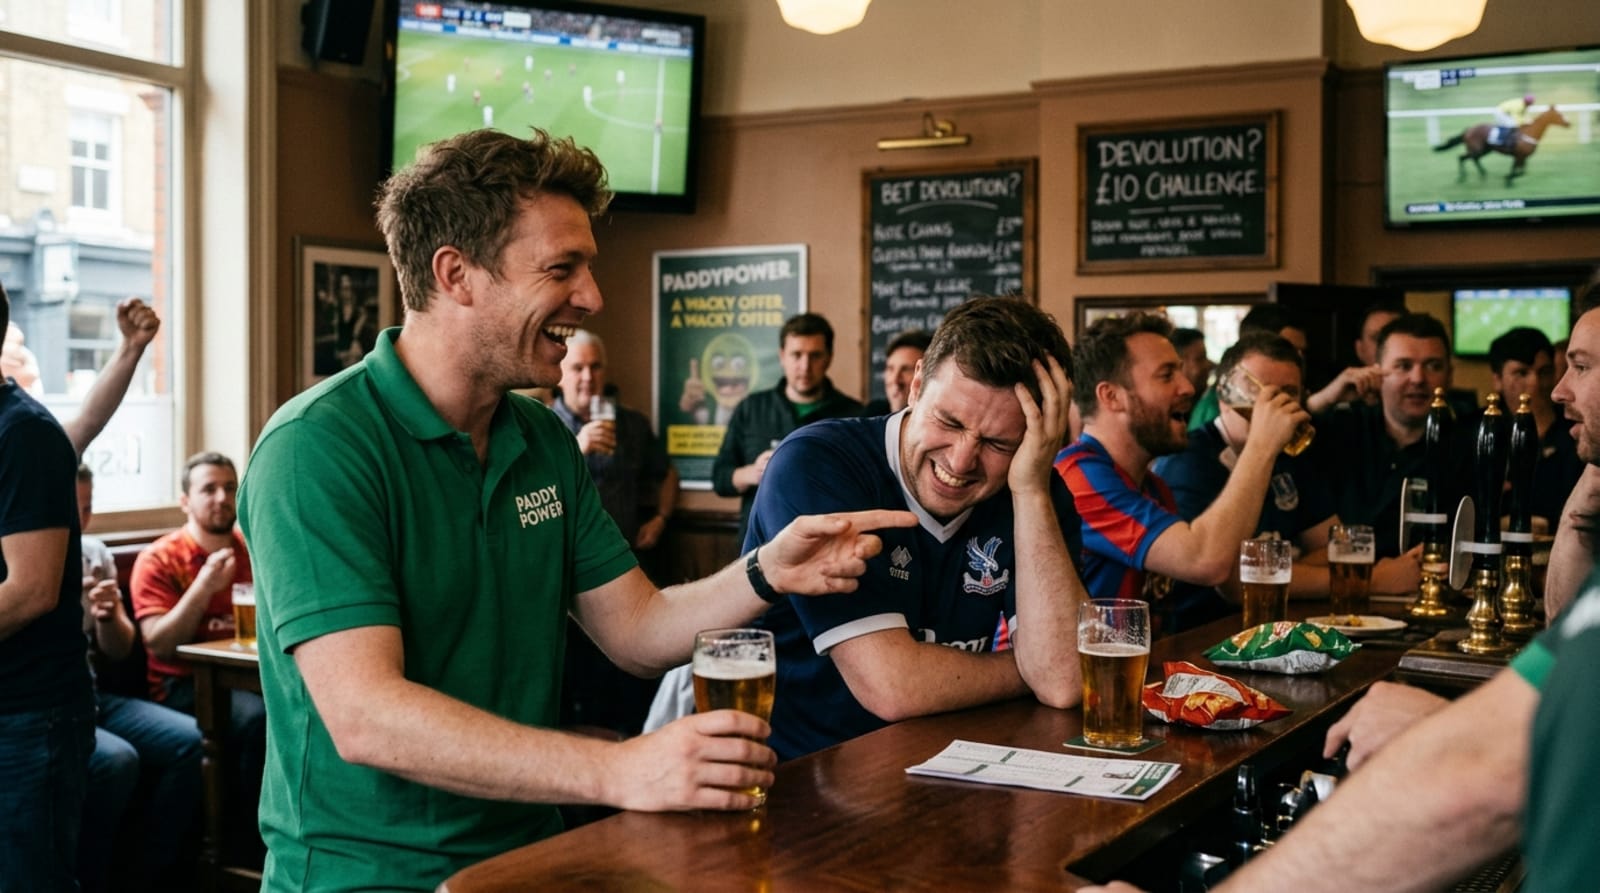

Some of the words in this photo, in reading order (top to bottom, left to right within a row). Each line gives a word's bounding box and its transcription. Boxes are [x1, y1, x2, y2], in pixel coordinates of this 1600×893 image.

[1098, 128, 1263, 168] DEVOLUTION?
[881, 181, 914, 205] BET
[919, 172, 1022, 200] DEVOLUTION?
[1096, 172, 1140, 205] £10
[671, 298, 682, 311] A
[684, 296, 736, 311] WACKY
[671, 313, 683, 328] A
[684, 312, 736, 327] WACKY
[515, 485, 558, 512] PADDY
[519, 501, 564, 528] POWER
